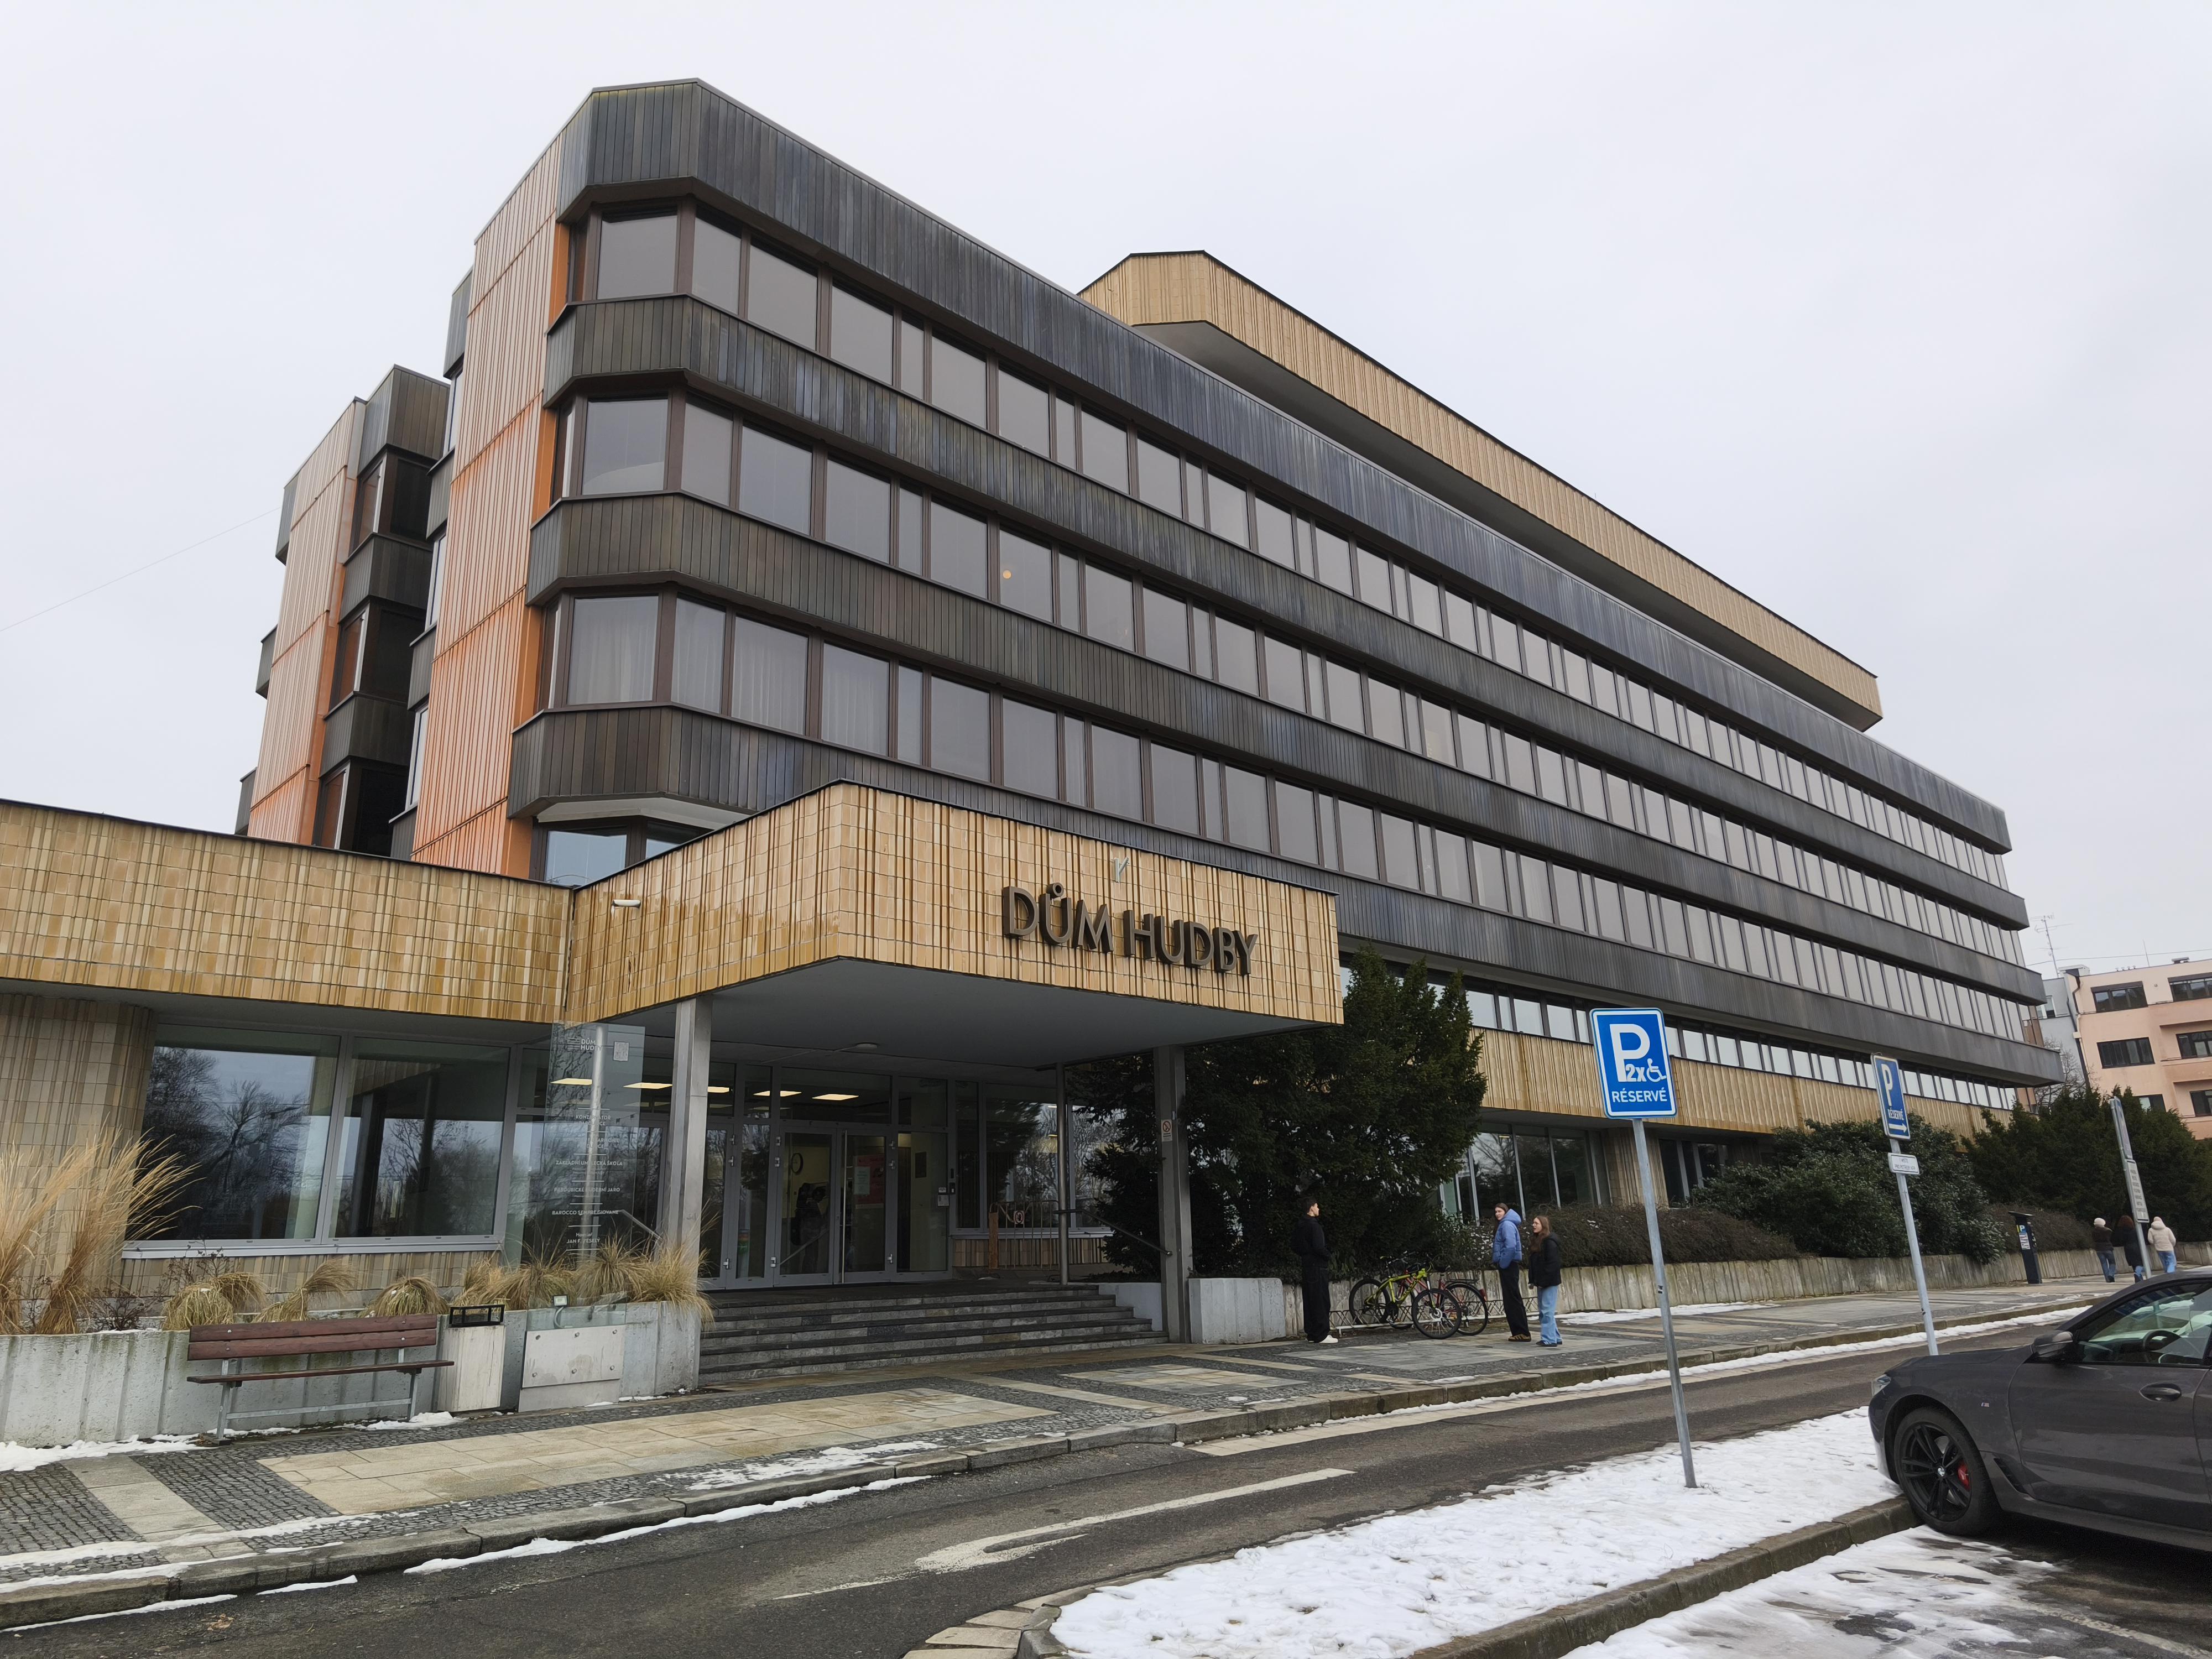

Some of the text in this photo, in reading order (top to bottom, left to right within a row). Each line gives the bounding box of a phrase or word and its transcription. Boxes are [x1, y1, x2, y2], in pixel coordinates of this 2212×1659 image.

[1003, 882, 1258, 975] DŮM HUDBY
[1610, 1024, 1650, 1082] P
[1626, 1063, 1647, 1082] 2x
[1611, 1087, 1667, 1103] RÉSERVÉ
[1881, 1063, 1893, 1107] P
